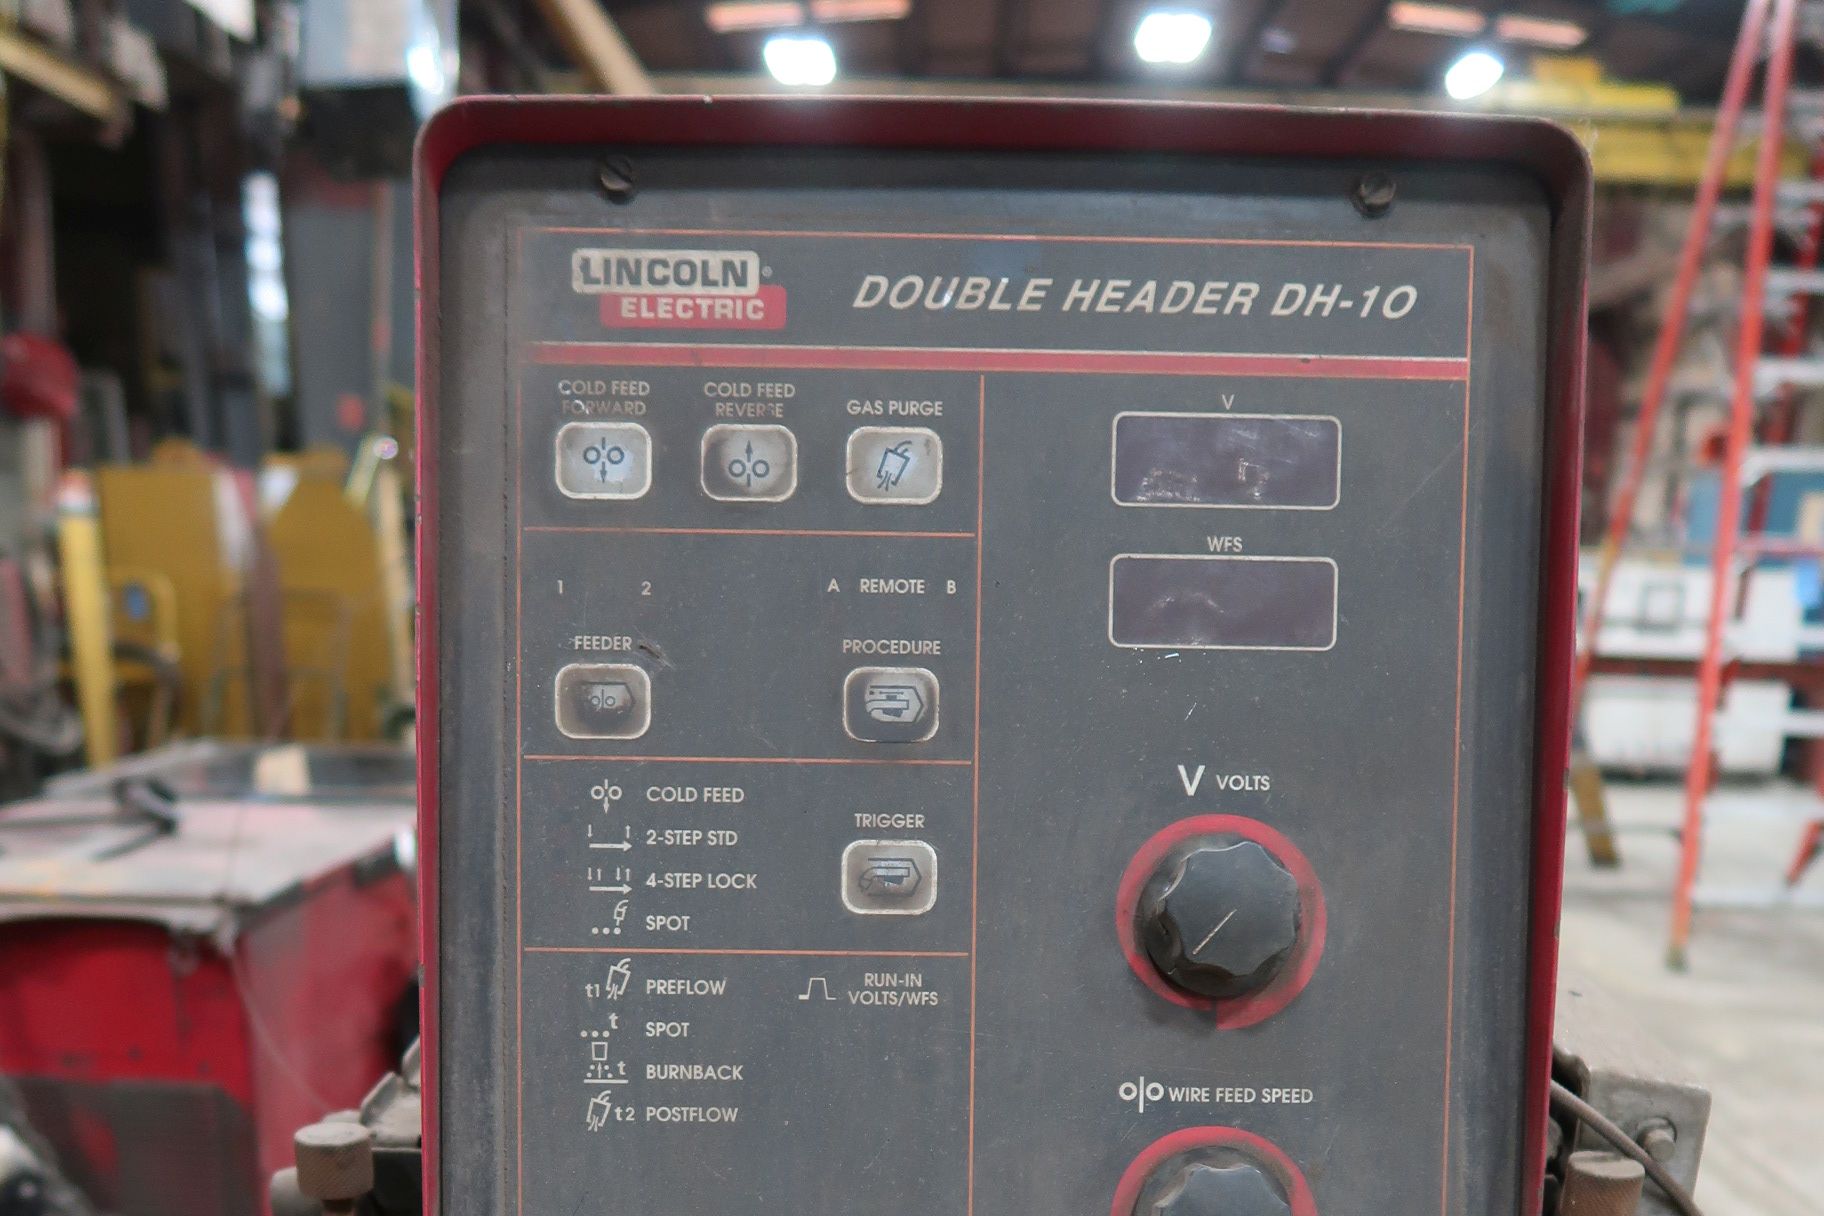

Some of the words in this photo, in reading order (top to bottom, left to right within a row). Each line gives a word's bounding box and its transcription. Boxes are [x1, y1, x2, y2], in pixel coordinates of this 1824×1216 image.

[578, 257, 749, 289] LINCOLN
[852, 273, 1054, 311] DOUBLE
[1062, 278, 1260, 318] HEADER
[1271, 281, 1419, 320] DH-10
[620, 297, 765, 320] ELECTRIC
[558, 379, 606, 396] COLD
[611, 380, 650, 396] FEED
[703, 381, 752, 398] COLD
[757, 382, 796, 398] FEED
[562, 399, 647, 416] FORWARD
[846, 400, 884, 416] GAS
[889, 401, 944, 417] PURGE
[1222, 394, 1235, 410] V
[1207, 536, 1244, 553] WFS
[556, 580, 564, 595] 1
[641, 581, 652, 596] 2
[827, 578, 840, 593] A
[860, 579, 926, 594] REMOTE
[947, 580, 957, 595] B
[574, 636, 633, 651] FEEDER
[843, 639, 941, 655] PROCEDURE
[1177, 764, 1206, 797] V
[1216, 775, 1270, 791] VOLTS
[646, 787, 698, 803] COLD
[704, 787, 745, 803] FEED
[854, 813, 925, 829] TRIGGER
[646, 830, 702, 846] 2-STEP
[707, 830, 738, 846] STD
[646, 873, 702, 889] 4-STEP
[708, 873, 758, 889] LOCK
[645, 915, 690, 932] SPOT
[646, 979, 727, 996] PREFLOW
[864, 973, 922, 988] RUN-IN
[848, 991, 939, 1007] VOLTS/WFS
[645, 1022, 690, 1038] SPOT
[646, 1065, 744, 1081] BURNBACK
[1169, 1087, 1210, 1102] WIRE
[1216, 1087, 1256, 1103] FEED
[1261, 1088, 1314, 1104] SPEED
[646, 1106, 738, 1123] POSTFLOW
